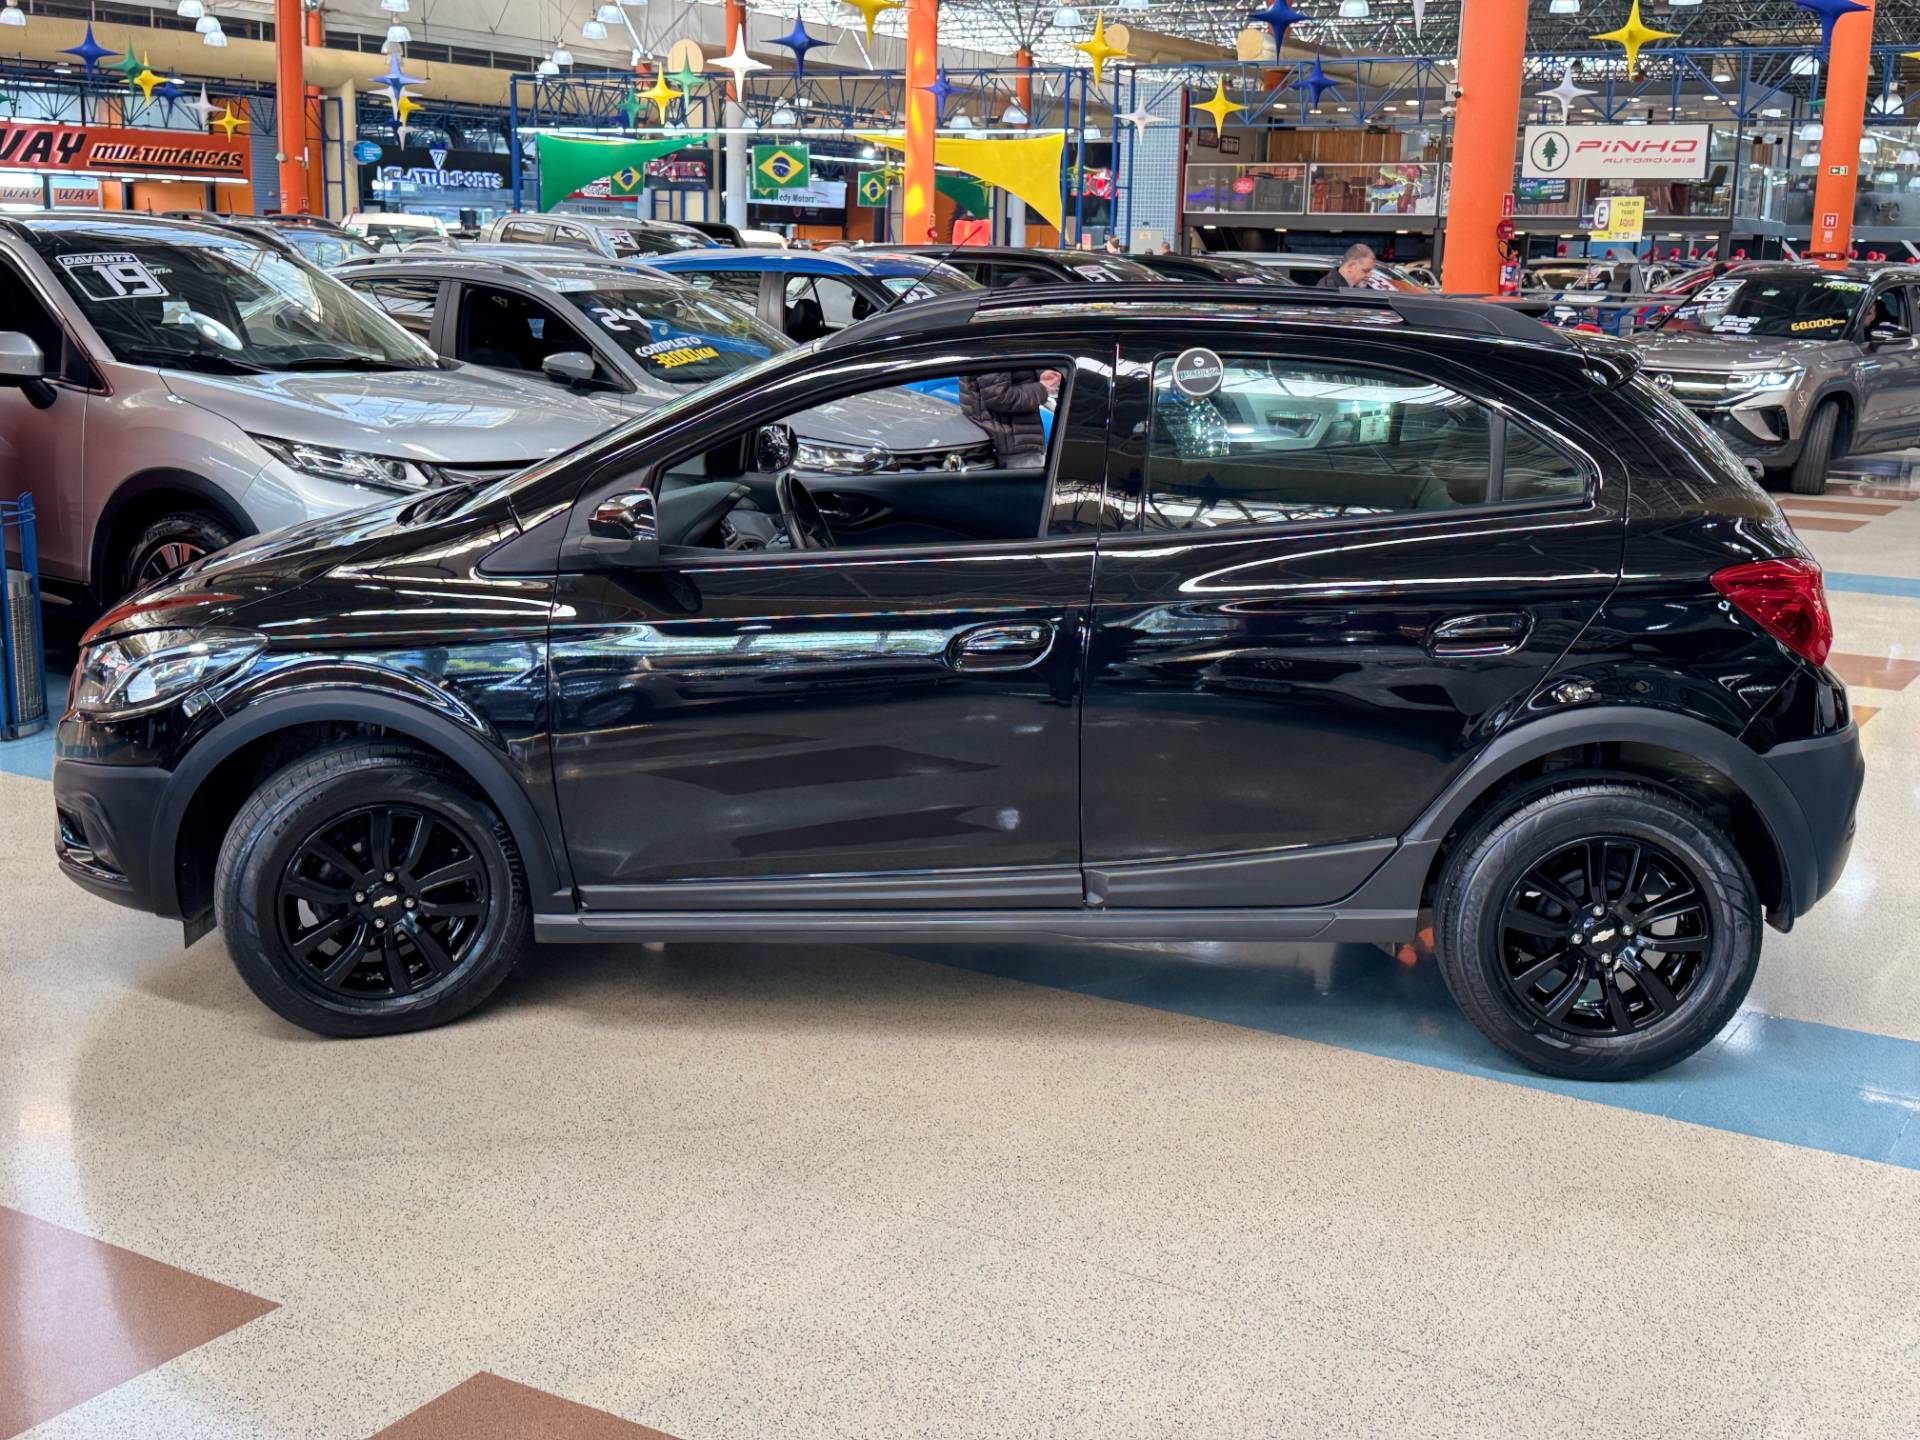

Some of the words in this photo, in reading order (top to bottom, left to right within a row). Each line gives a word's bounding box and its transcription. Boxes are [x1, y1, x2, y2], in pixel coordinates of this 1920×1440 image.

[58, 188, 95, 200] WAY
[1597, 206, 1607, 225] E
[62, 254, 134, 265] DAVANTI
[92, 264, 162, 295] 19
[591, 307, 653, 331] 24
[635, 336, 702, 357] COMPLETO
